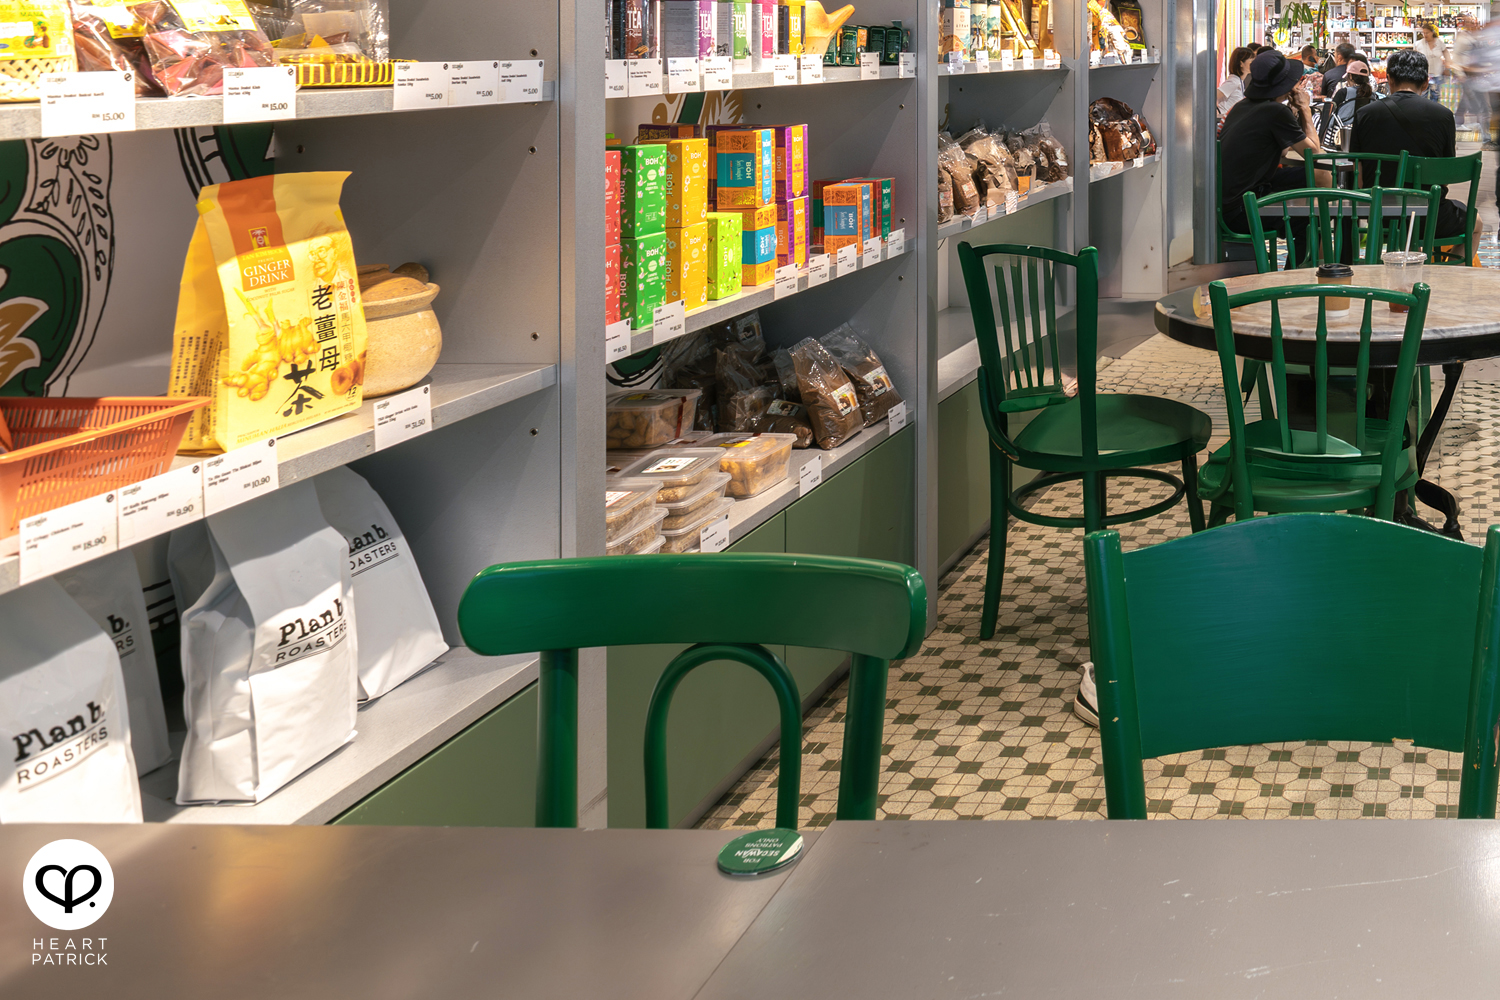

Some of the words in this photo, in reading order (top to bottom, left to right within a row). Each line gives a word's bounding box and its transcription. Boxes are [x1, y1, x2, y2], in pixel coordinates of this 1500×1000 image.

[627, 10, 642, 29] TEA
[700, 13, 712, 30] TEA
[734, 14, 746, 30] TEA
[762, 15, 774, 32] TEA
[790, 16, 801, 32] TEA
[270, 102, 288, 111] 15.00
[102, 112, 125, 122] 15.00
[645, 156, 659, 166] BOH
[690, 150, 702, 160] BOH
[689, 236, 702, 245] BOH
[646, 247, 659, 257] BOH
[244, 259, 292, 278] GINGER
[250, 270, 290, 288] DRINK
[246, 293, 269, 302] COCONUT
[312, 284, 340, 372] 老薑母
[276, 360, 326, 418] 茶
[412, 418, 426, 429] 31.50
[236, 428, 268, 444] MINUMAN
[252, 476, 271, 489] 10.90
[176, 504, 194, 518] 9.90
[82, 535, 107, 551] 18.90
[350, 542, 398, 571] OASTERS
[277, 609, 334, 648] Plan
[275, 619, 347, 662] ROASTERS
[12, 714, 87, 763] Plan
[17, 726, 108, 784] ROASTERS
[734, 848, 780, 858] SECAWAN
